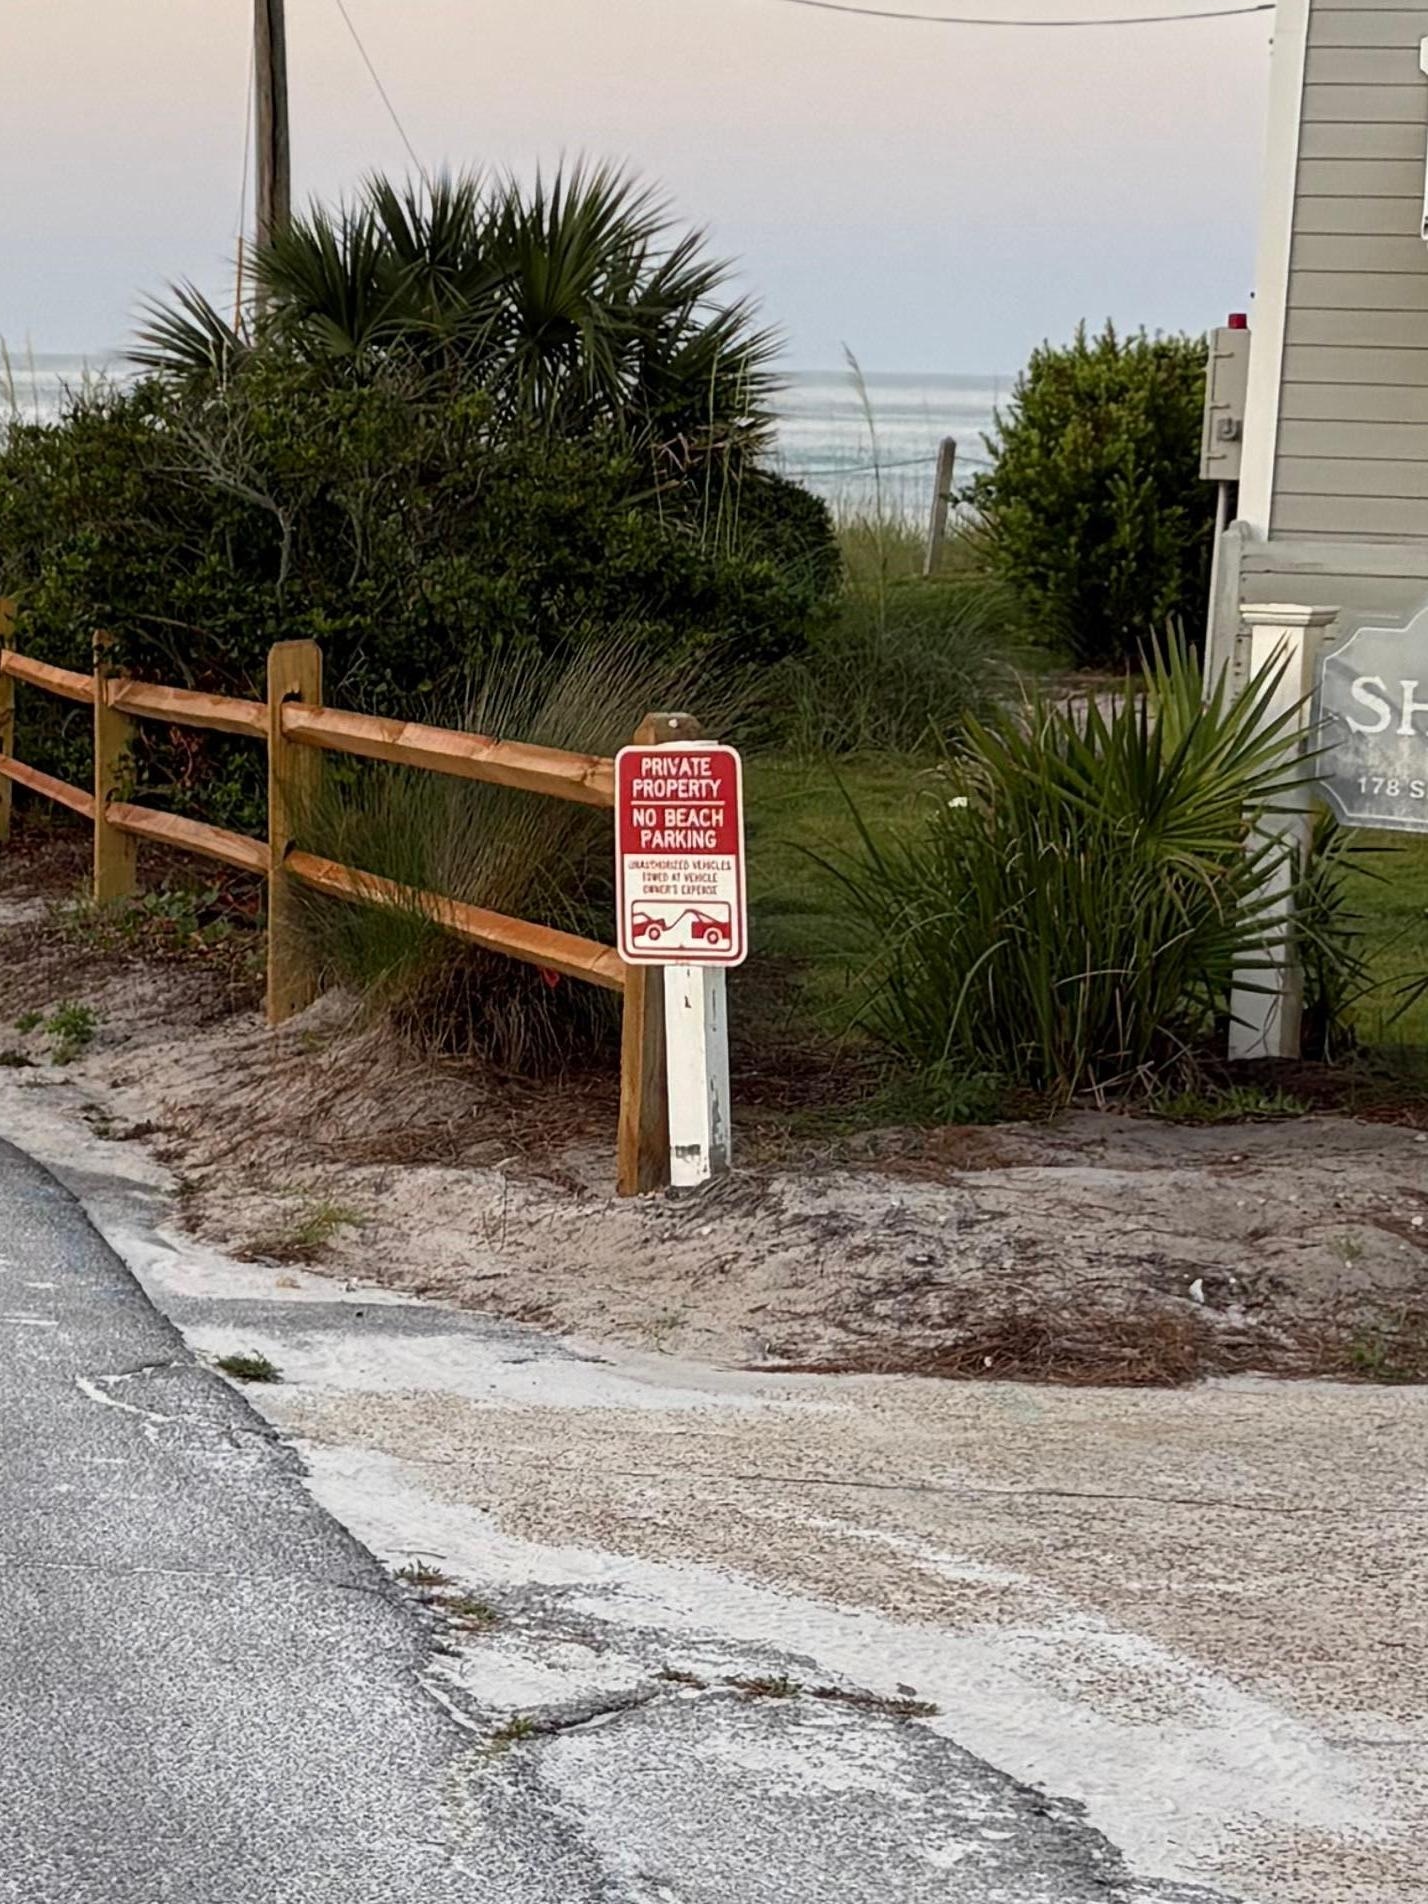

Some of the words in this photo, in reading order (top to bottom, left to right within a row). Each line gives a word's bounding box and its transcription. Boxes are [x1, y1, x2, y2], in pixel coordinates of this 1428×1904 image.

[641, 757, 712, 777] PRIVATE
[632, 778, 722, 798] PROPERTY
[1357, 776, 1400, 797] 178
[1409, 779, 1428, 800] S
[632, 808, 657, 827] NO
[664, 808, 724, 828] BEACH
[640, 829, 717, 849] PARKING
